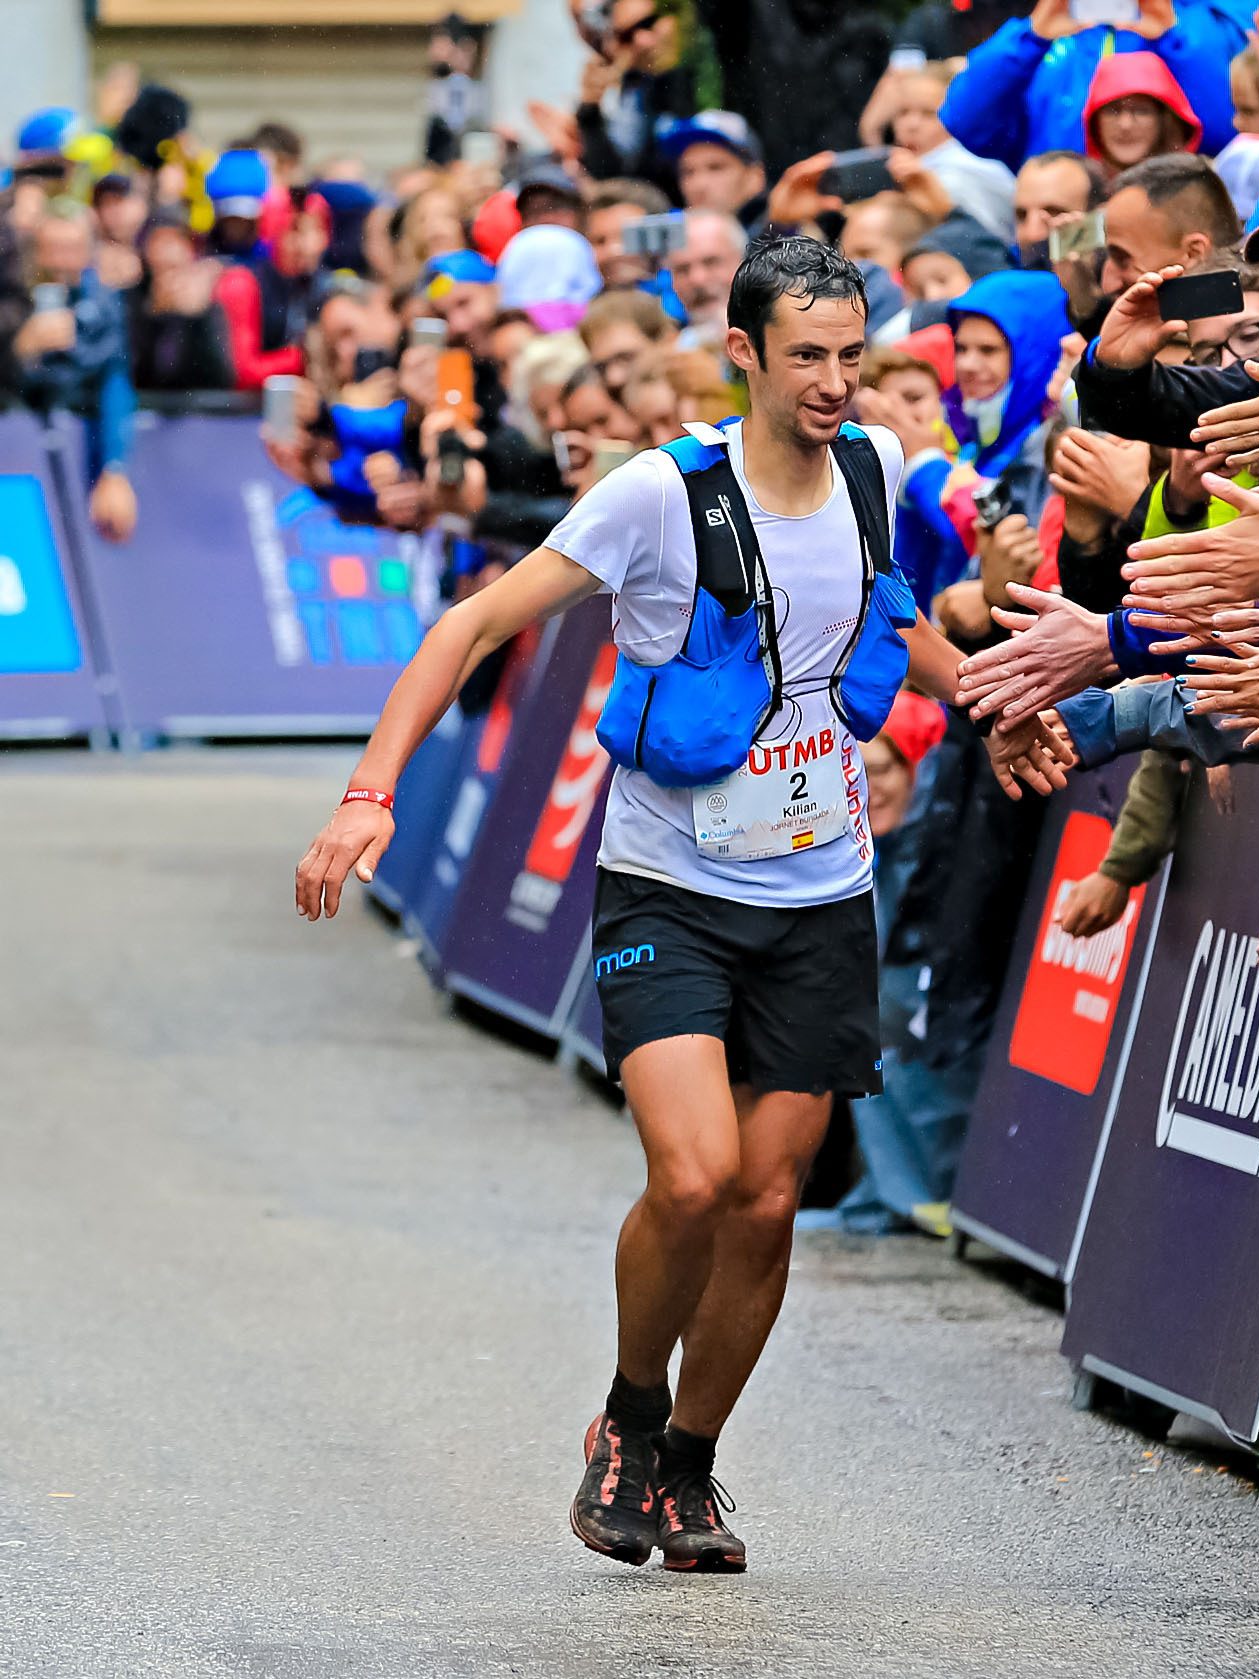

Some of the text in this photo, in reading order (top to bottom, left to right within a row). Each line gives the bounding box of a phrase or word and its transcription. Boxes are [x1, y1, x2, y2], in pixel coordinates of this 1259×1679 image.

[748, 728, 835, 775] UTMB
[789, 771, 809, 801] 2
[783, 802, 817, 818] Kilian
